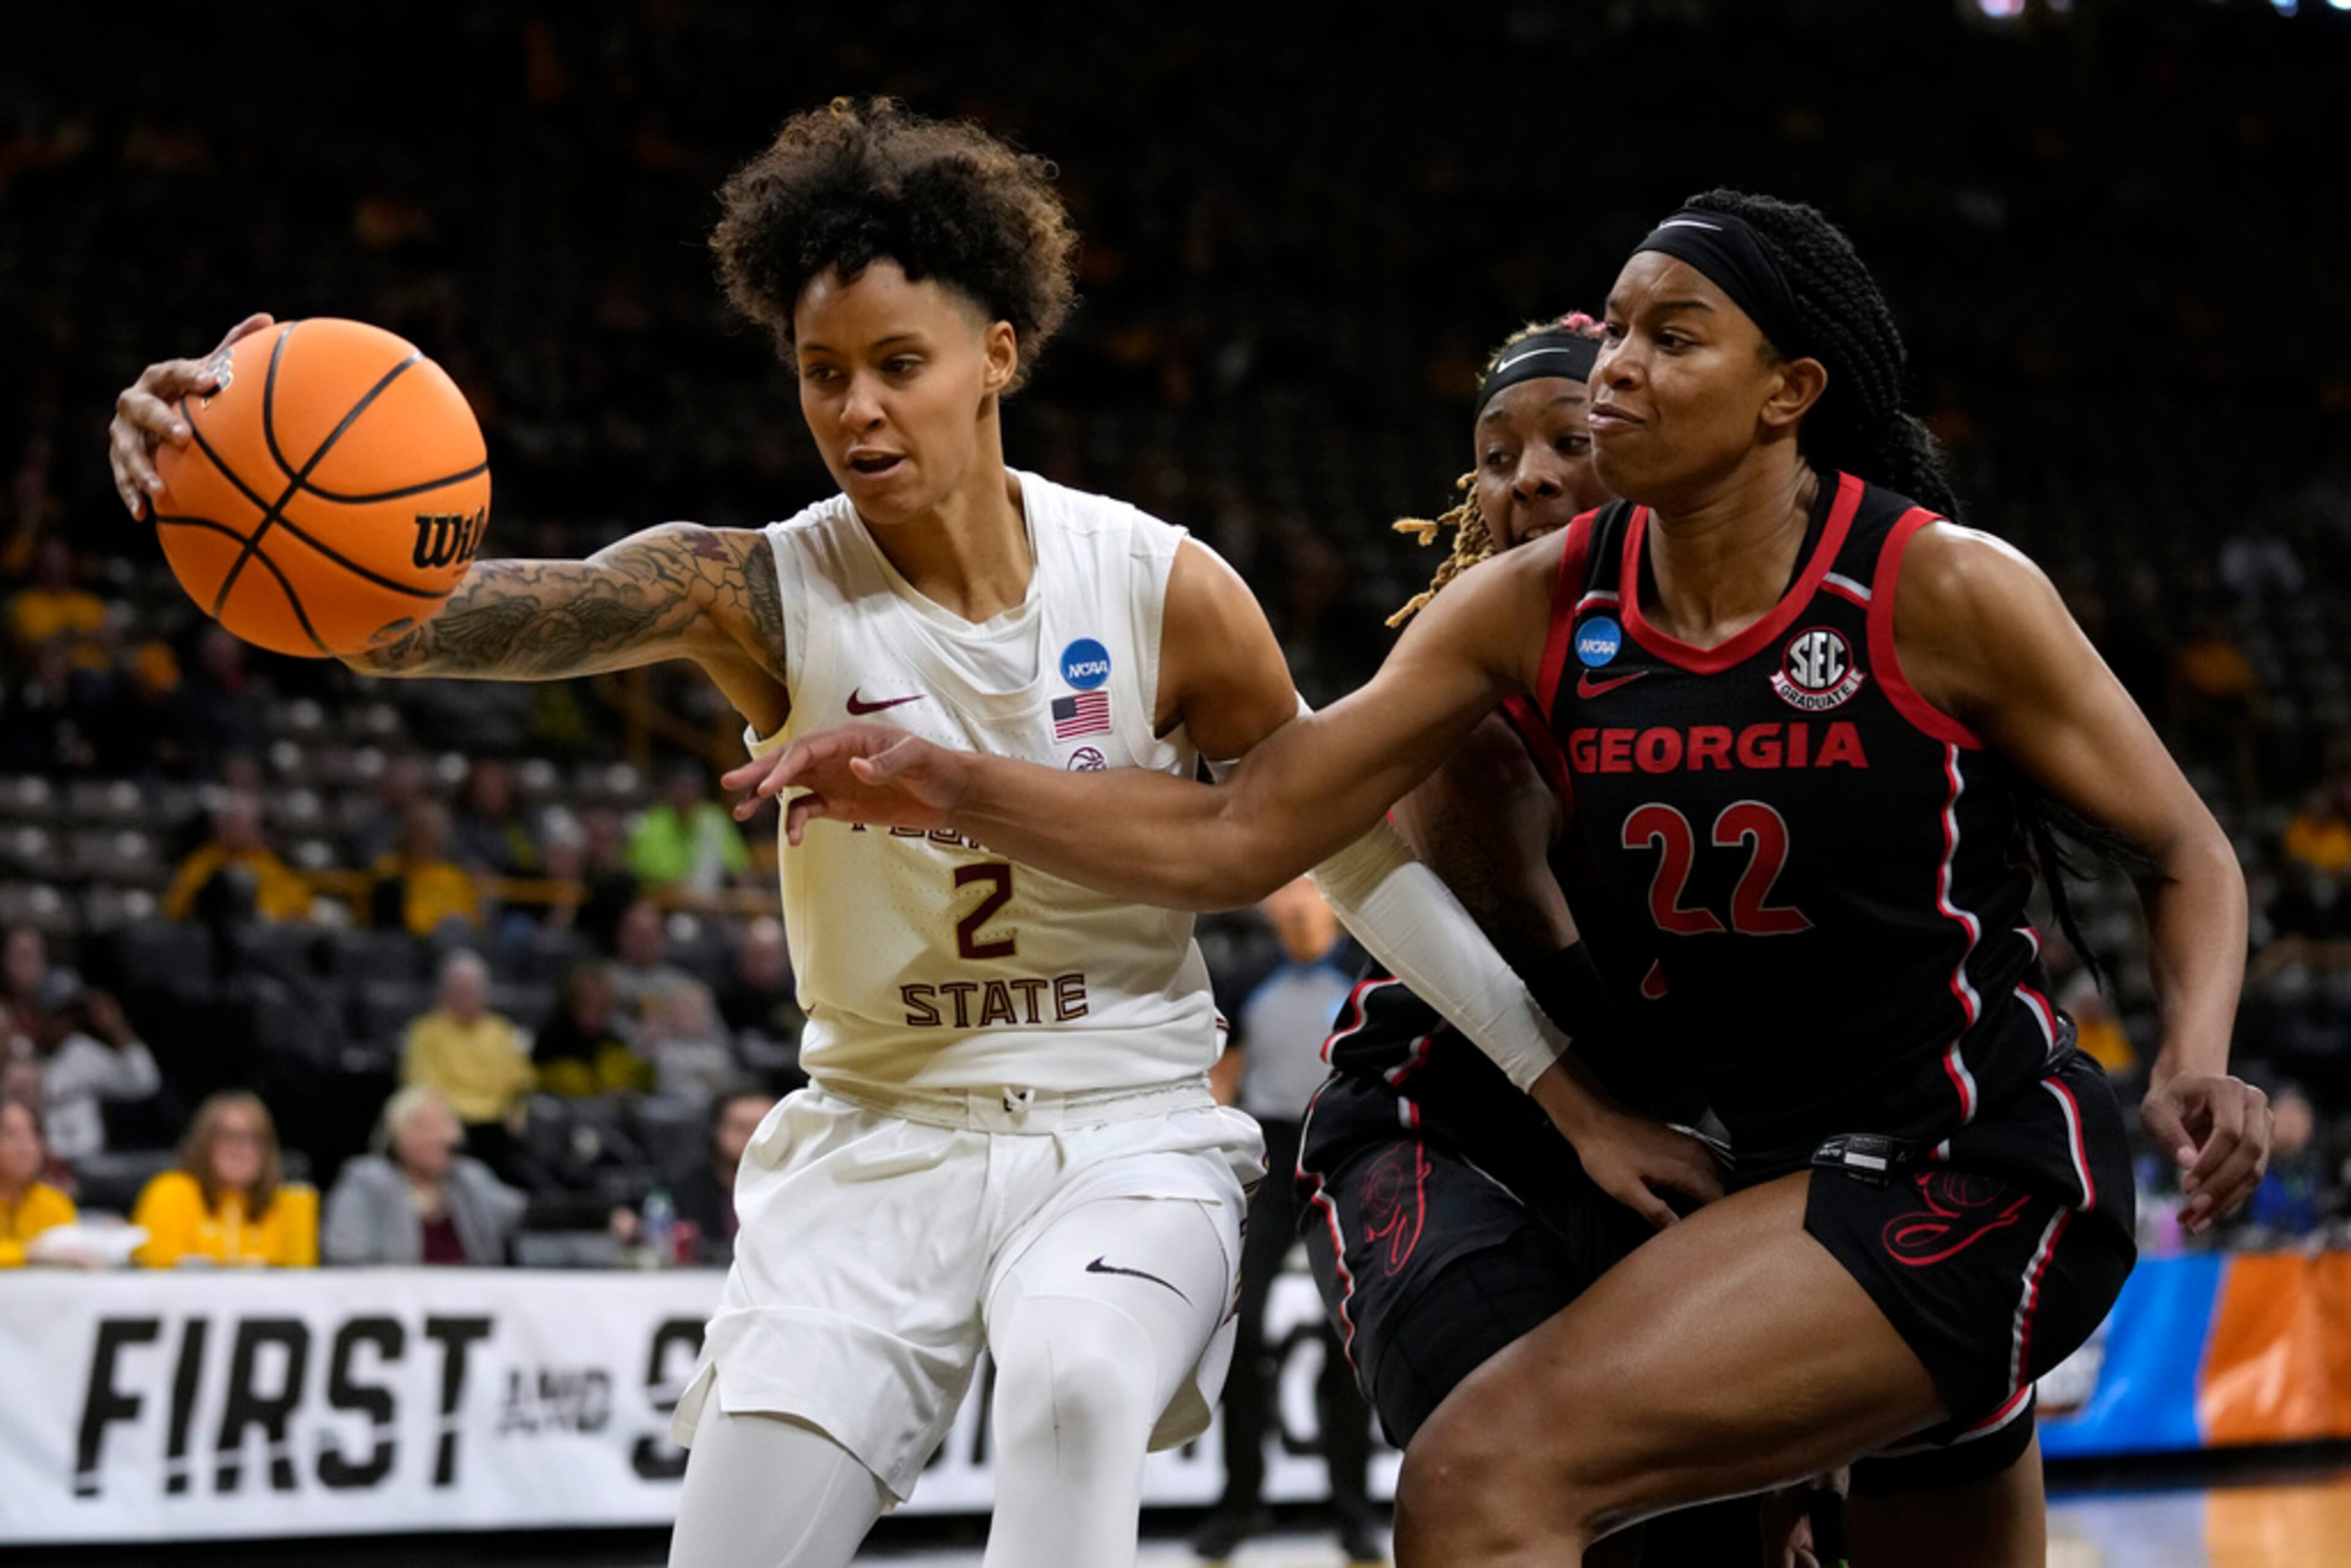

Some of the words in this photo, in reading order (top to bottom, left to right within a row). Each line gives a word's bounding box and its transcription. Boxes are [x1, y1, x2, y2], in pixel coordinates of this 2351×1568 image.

[1068, 660, 1108, 679] NCAA
[1579, 639, 1616, 655] NCAA
[1790, 631, 1845, 689] SEC
[1781, 683, 1850, 708] GRADUATE
[1569, 722, 1869, 774] GEORGIA
[1621, 800, 1815, 936] 22
[953, 861, 1016, 960] 2
[900, 973, 1089, 1027] STATE
[70, 1315, 497, 1498] FIRST
